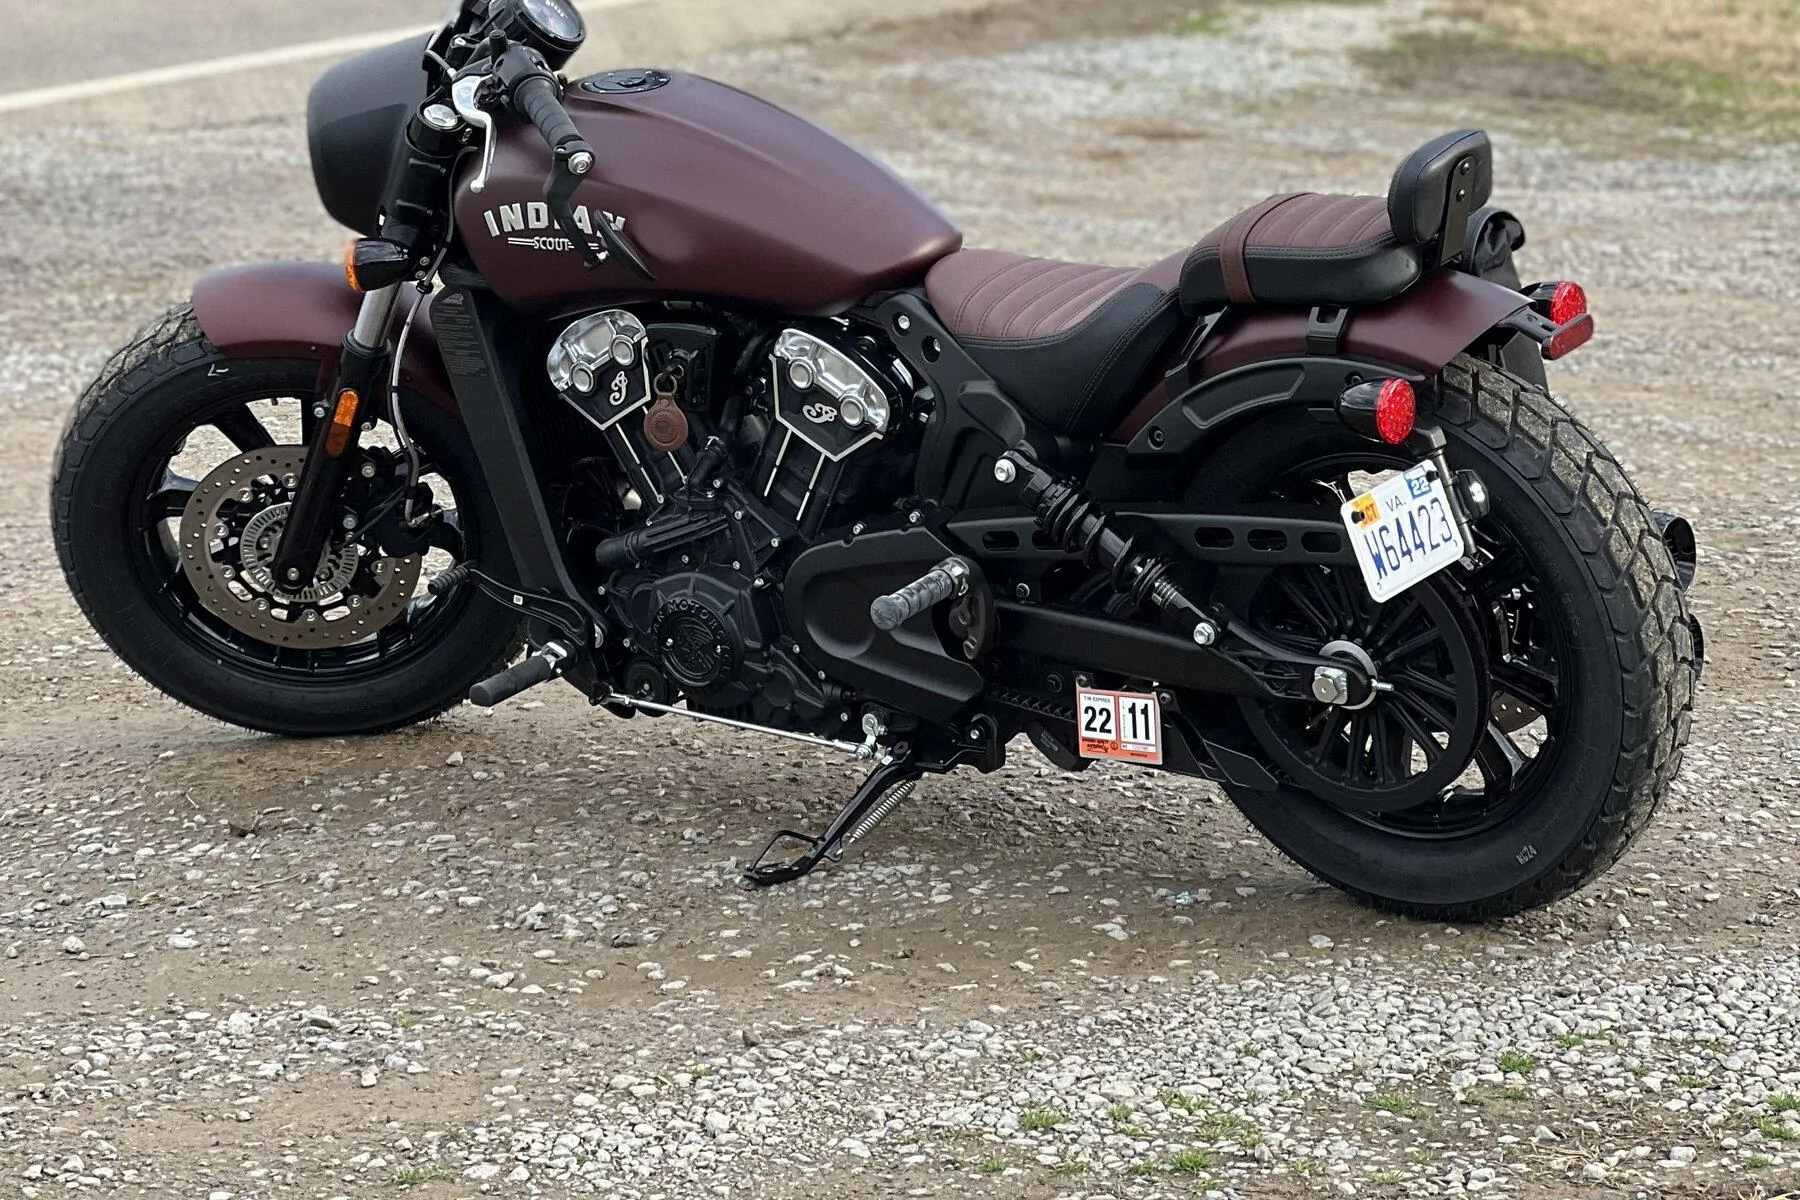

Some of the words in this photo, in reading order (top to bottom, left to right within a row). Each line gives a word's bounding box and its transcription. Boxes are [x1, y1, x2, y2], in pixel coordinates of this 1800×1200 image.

[484, 202, 626, 240] INDAN
[533, 236, 570, 251] SCOUT
[1410, 477, 1430, 494] 22
[1363, 497, 1453, 580] W64423
[1084, 706, 1112, 735] 22
[1128, 702, 1151, 741] 11
